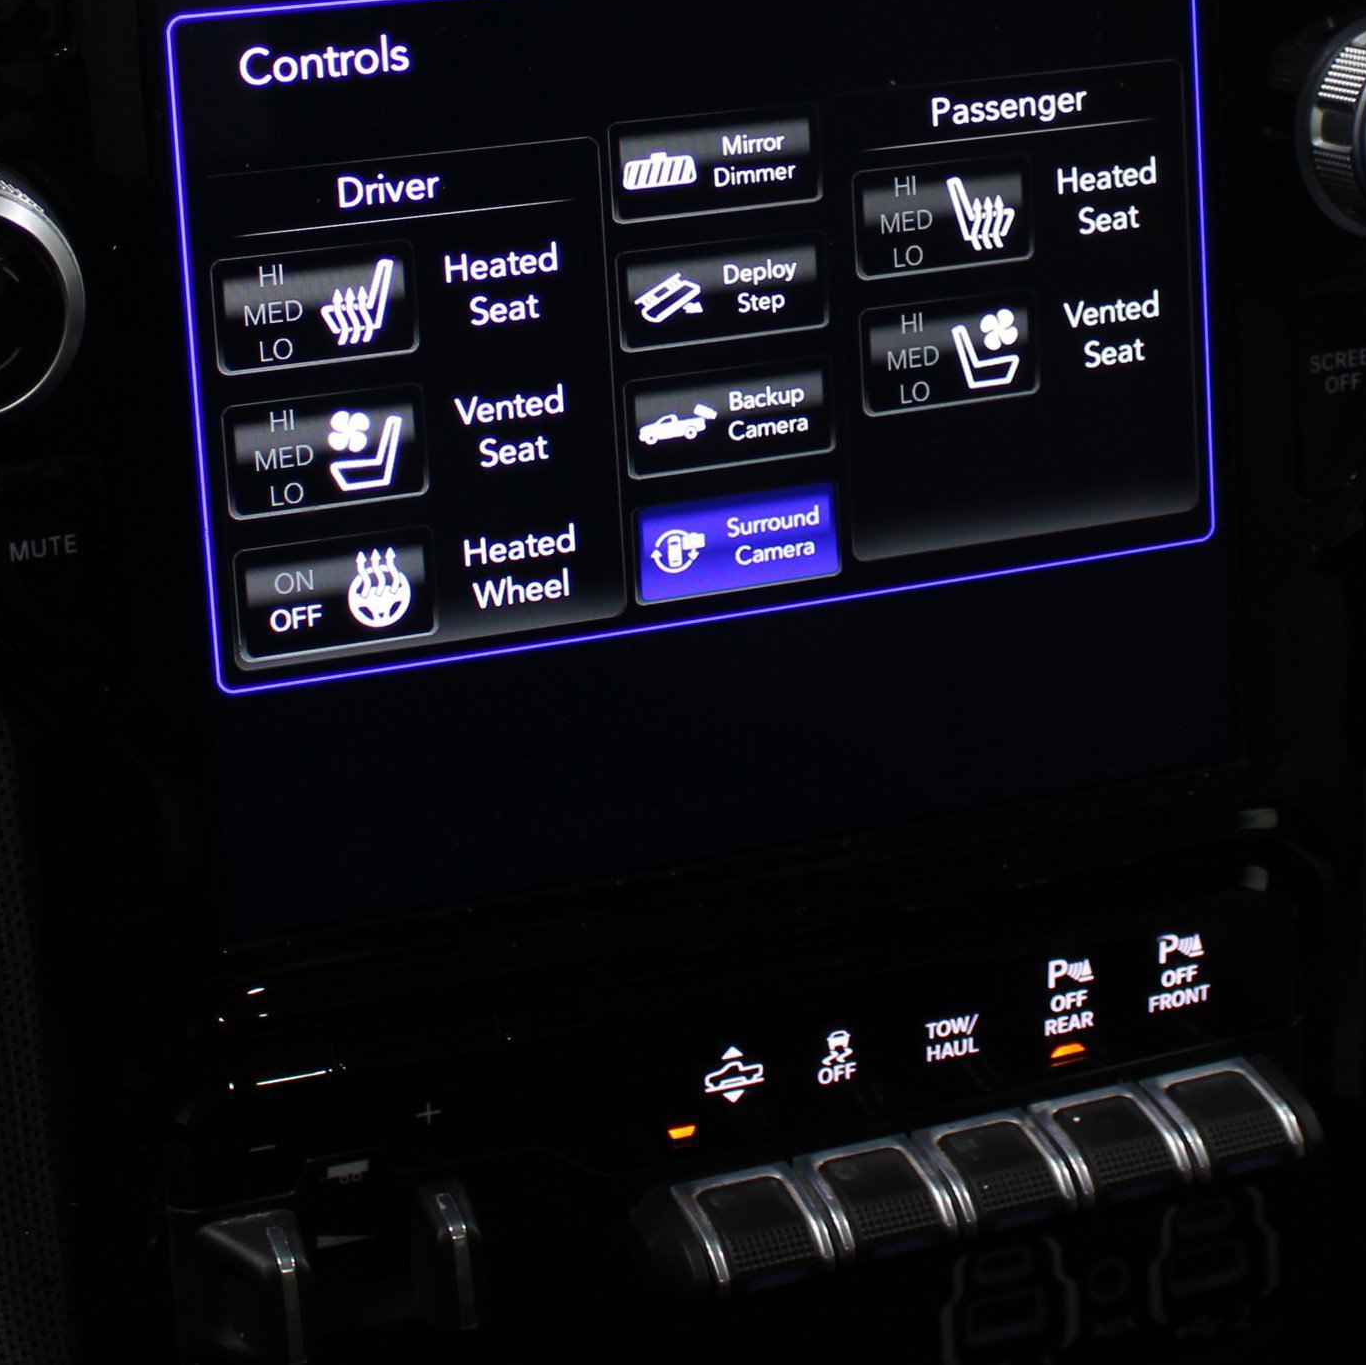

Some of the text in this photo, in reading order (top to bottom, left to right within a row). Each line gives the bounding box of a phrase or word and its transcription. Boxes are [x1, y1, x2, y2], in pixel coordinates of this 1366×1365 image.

[238, 33, 413, 89] Controls
[931, 88, 1088, 128] Passenger
[721, 133, 786, 157] Mirror
[713, 164, 797, 188] Dimmer
[893, 175, 918, 197] HI
[1056, 155, 1157, 195] Heated
[337, 173, 440, 209] Driver
[879, 207, 934, 235] MED
[1077, 205, 1141, 235] Seat
[444, 240, 560, 284] Heated
[893, 244, 923, 268] LO
[257, 264, 286, 288] HI
[722, 258, 798, 286] Deploy
[243, 298, 304, 327] MED
[469, 293, 541, 327] Seat
[737, 291, 786, 314] Step
[1062, 288, 1160, 329] Vented
[901, 312, 924, 335] HI
[259, 337, 294, 363] LO
[886, 342, 940, 371] MED
[1083, 338, 1146, 369] Seat
[899, 380, 931, 405] LO
[1324, 371, 1361, 395] OFF
[453, 382, 565, 426] Vented
[728, 385, 805, 412] Backup
[269, 409, 296, 434] HI
[727, 416, 809, 442] Camera
[254, 443, 315, 472] MED
[478, 435, 550, 469] Seat
[270, 482, 305, 508] LO
[726, 505, 820, 539] Surround
[9, 533, 78, 562] MUTE
[463, 521, 576, 568] Heated
[734, 537, 816, 567] Camera
[274, 568, 314, 595] ON
[472, 567, 570, 610] Wheel
[269, 602, 323, 633] OFF
[1158, 933, 1176, 966] P
[1047, 958, 1067, 989] P
[1160, 963, 1200, 988] OFF
[1049, 989, 1089, 1015] OFF
[1148, 982, 1212, 1015] FRONT
[925, 1013, 980, 1041] TOW/
[1044, 1011, 1095, 1038] REAR
[926, 1036, 980, 1064] HAUL
[818, 1061, 858, 1087] OFF
